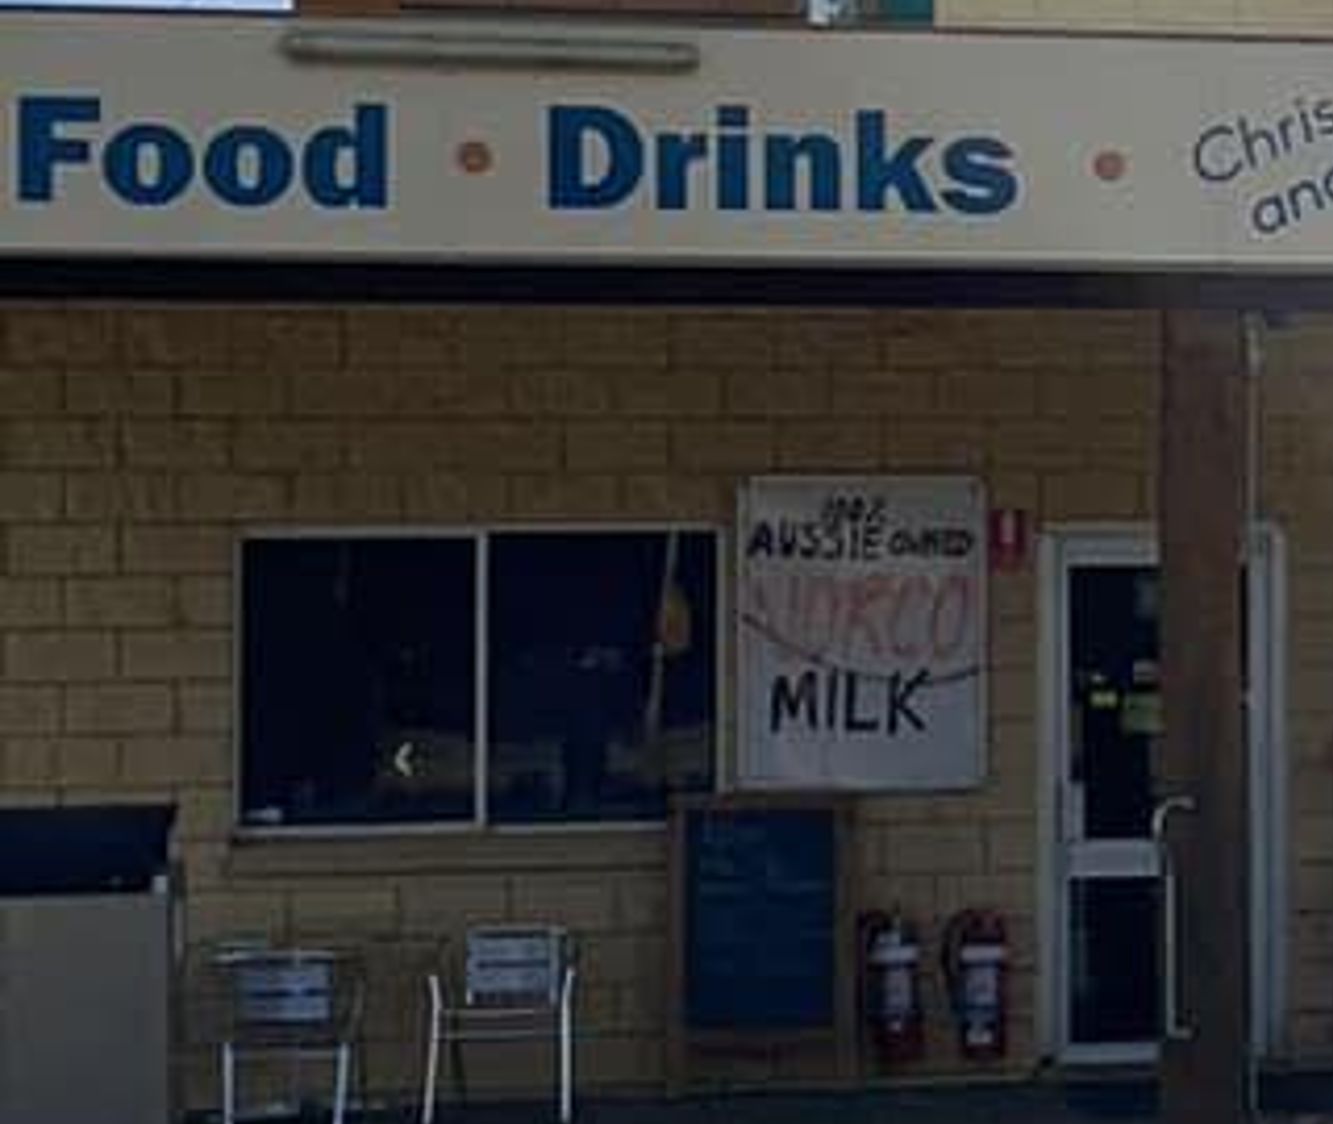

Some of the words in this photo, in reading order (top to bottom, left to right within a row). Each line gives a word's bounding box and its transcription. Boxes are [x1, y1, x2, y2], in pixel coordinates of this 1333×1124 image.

[16, 95, 391, 208] Food
[546, 104, 1019, 216] Drinks
[746, 518, 884, 561] AUSSIE
[769, 667, 929, 735] MILK
